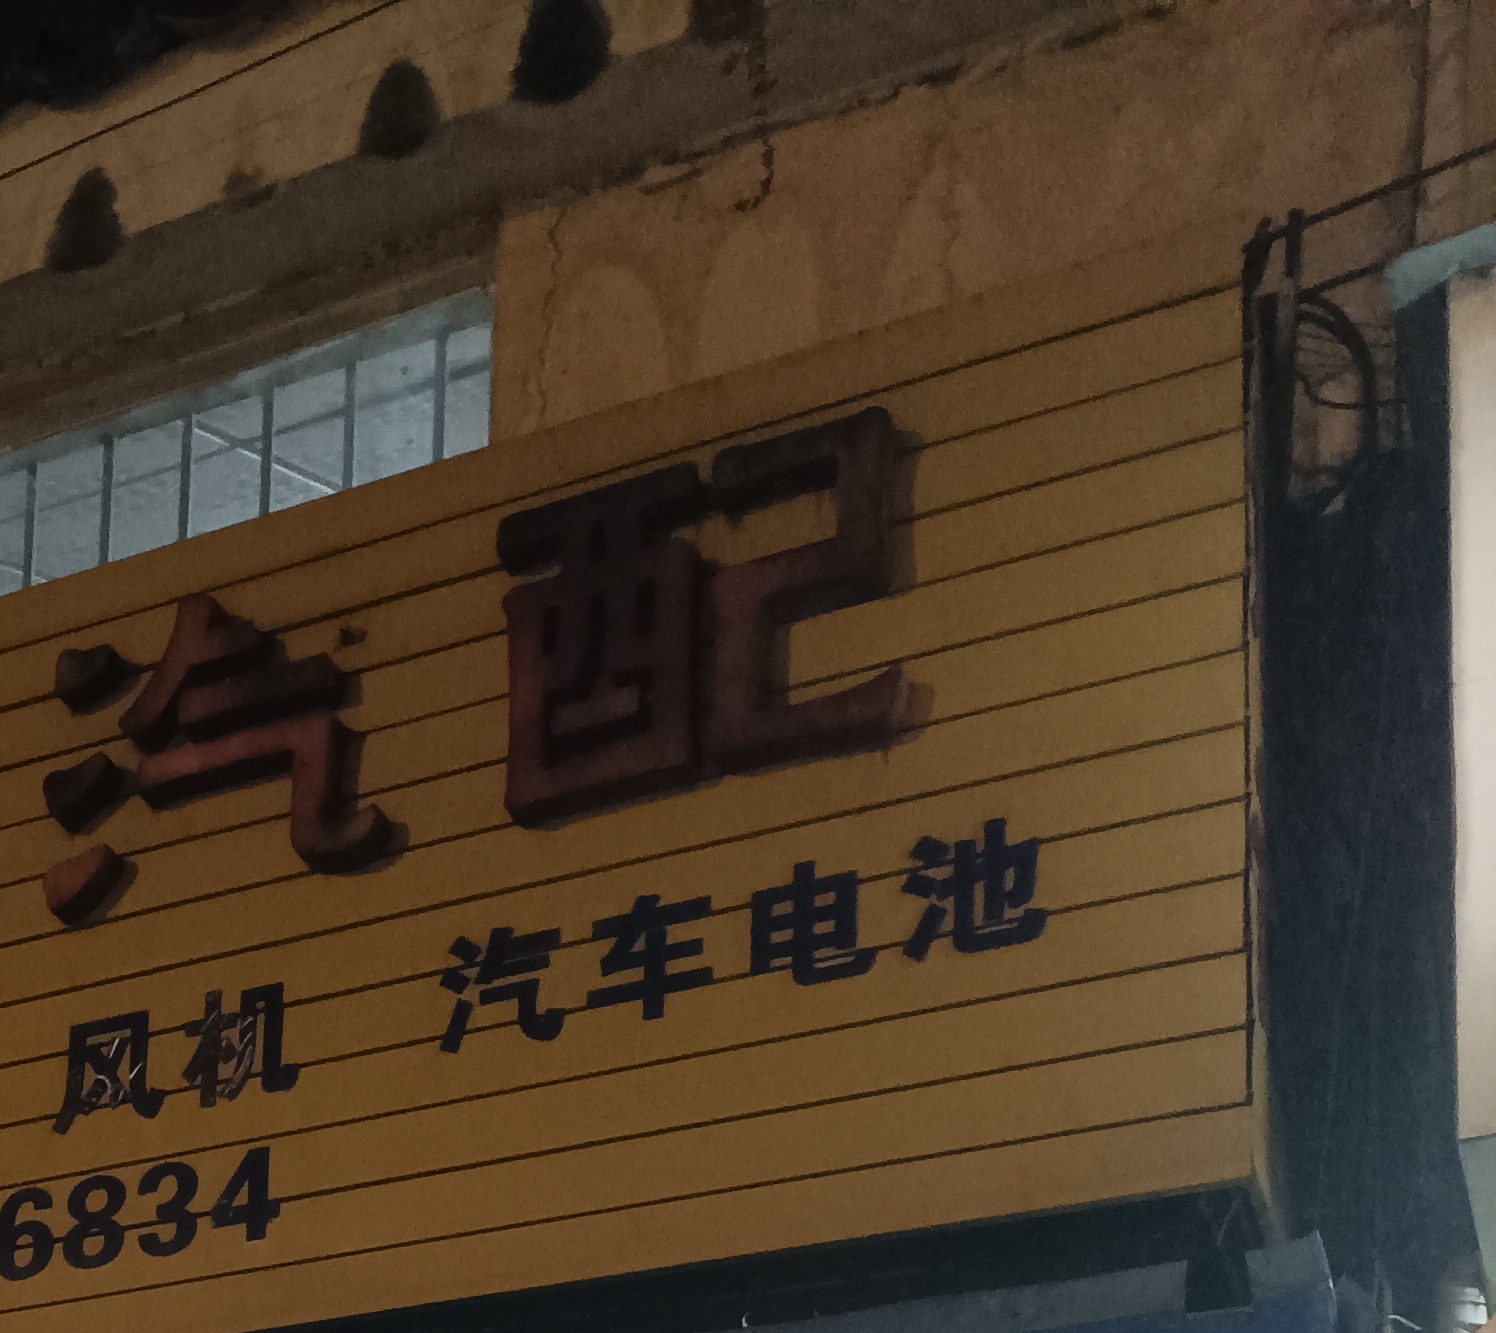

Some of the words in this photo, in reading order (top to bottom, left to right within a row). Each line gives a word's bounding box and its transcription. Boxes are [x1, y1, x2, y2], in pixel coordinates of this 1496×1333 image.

[52, 982, 300, 1135] 风机
[439, 818, 1048, 1054] 汽车电池
